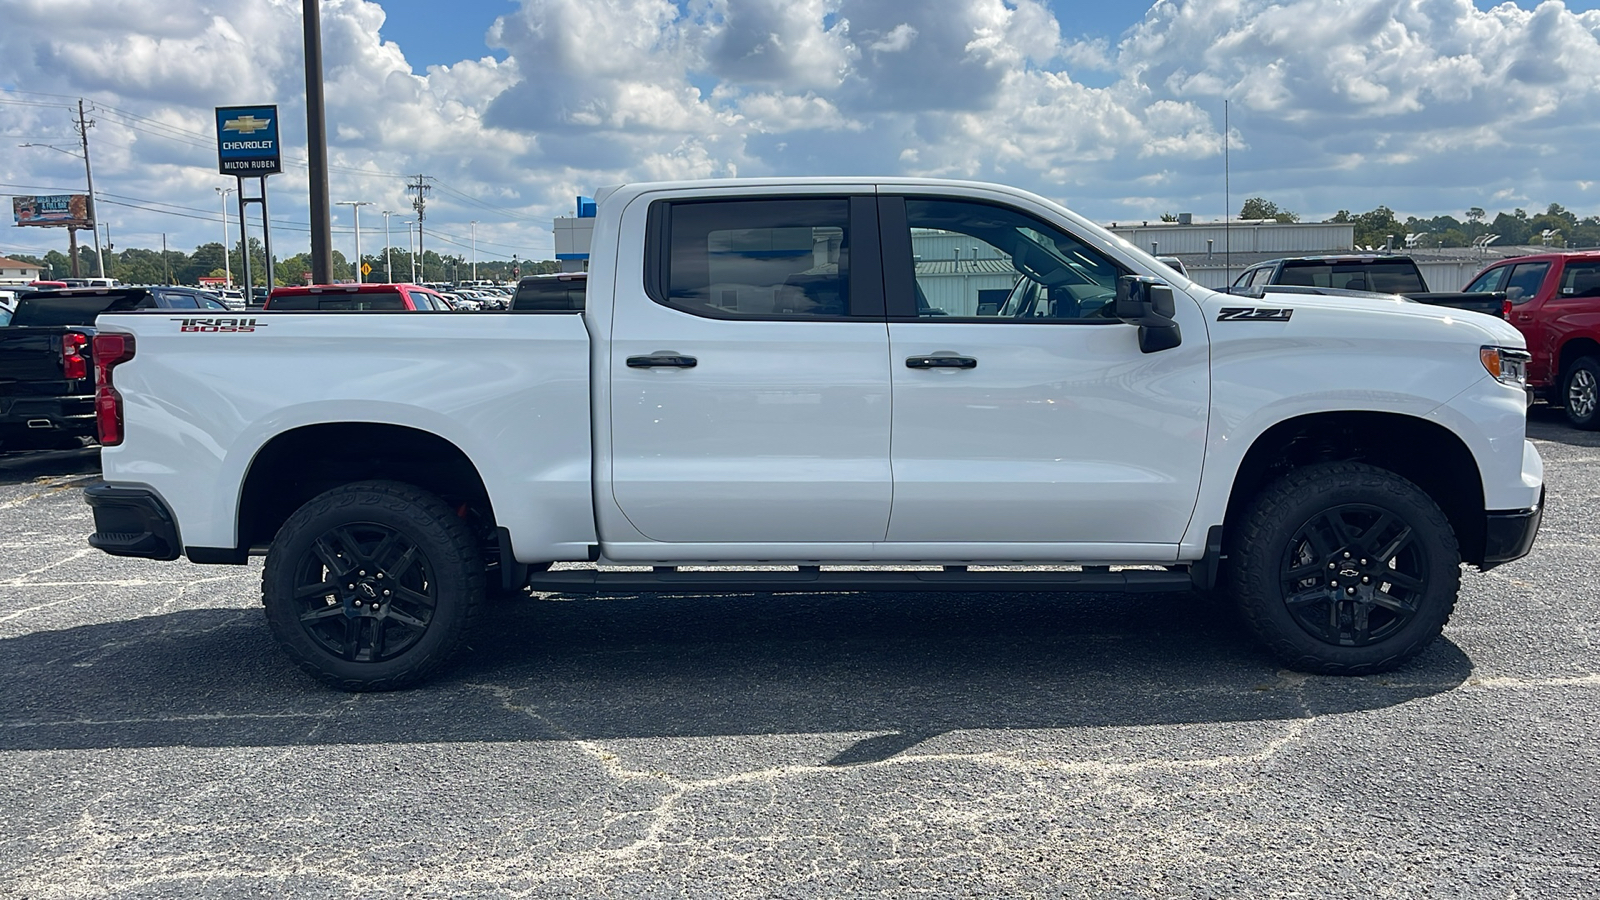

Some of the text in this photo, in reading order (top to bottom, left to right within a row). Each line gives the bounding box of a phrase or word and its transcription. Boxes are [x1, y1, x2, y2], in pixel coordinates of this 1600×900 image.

[223, 141, 273, 149] CHEVROLET
[224, 161, 249, 169] MILTON
[1216, 307, 1294, 322] Z71
[170, 318, 268, 327] TRAIL
